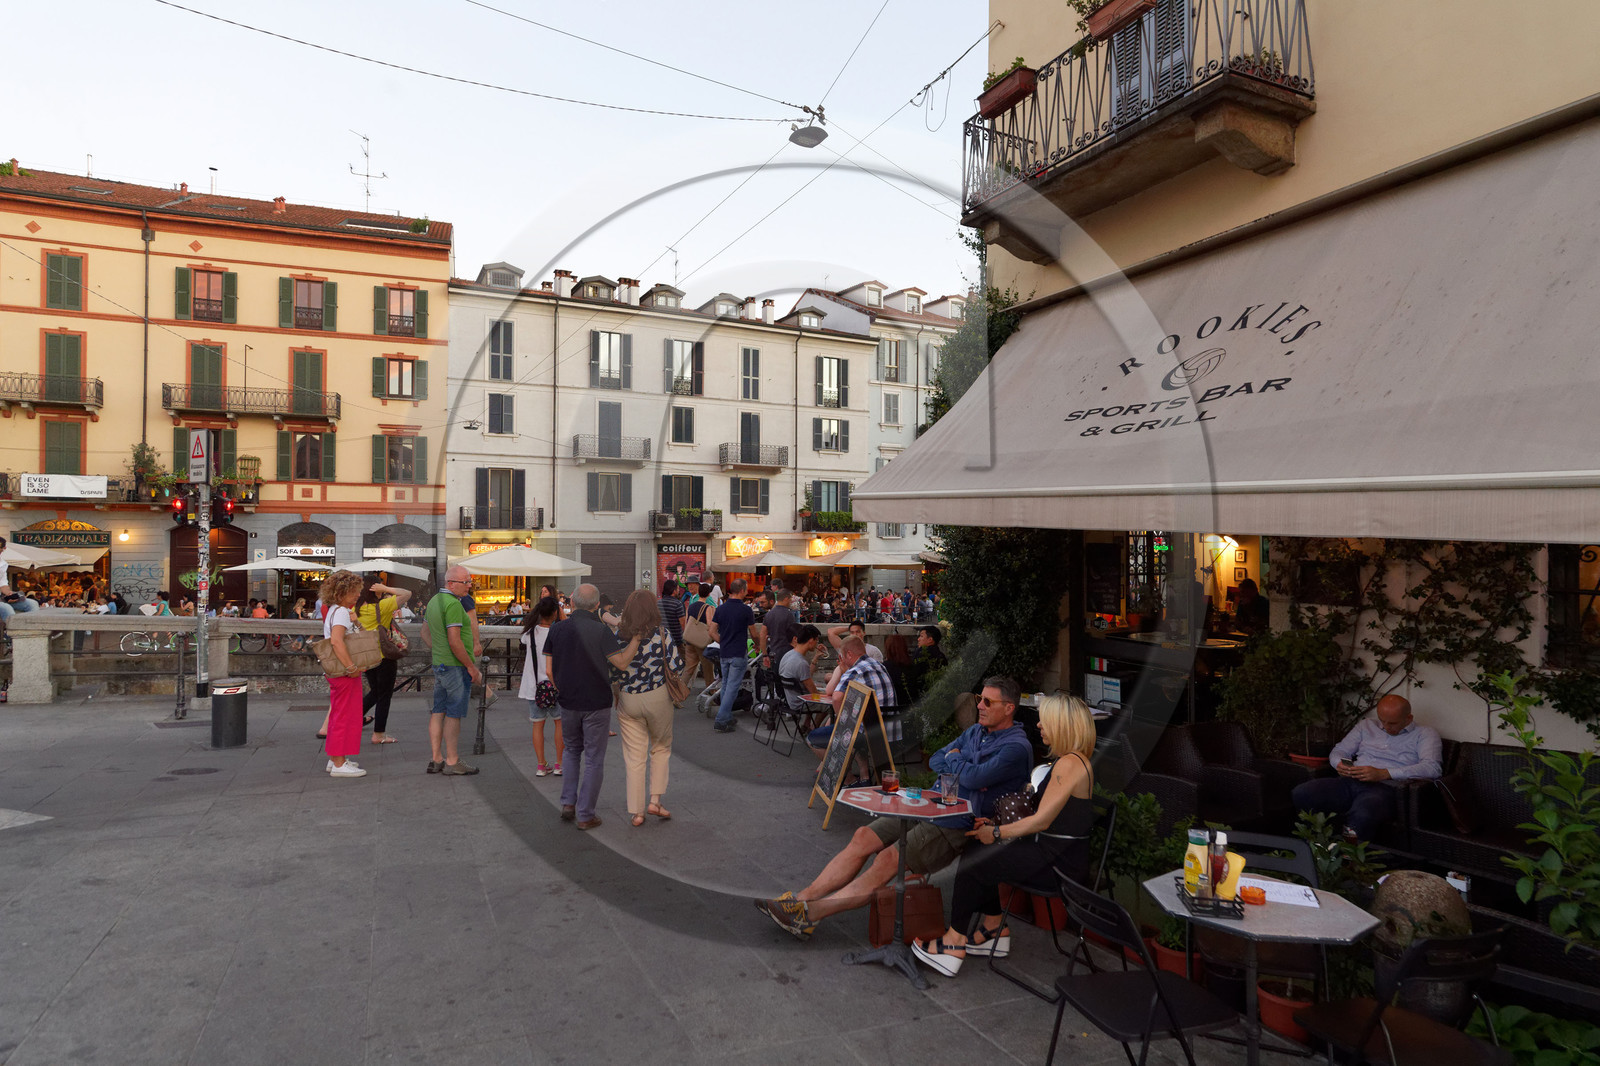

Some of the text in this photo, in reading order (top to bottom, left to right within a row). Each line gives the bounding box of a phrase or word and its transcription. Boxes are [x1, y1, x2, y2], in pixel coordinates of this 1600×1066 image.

[1118, 301, 1322, 377] ROOKIES
[1064, 377, 1293, 422] SPORTS BAR
[1080, 411, 1218, 437] & GRILL
[16, 534, 108, 543] TRADIZIONALE
[662, 544, 702, 553] coiffeur
